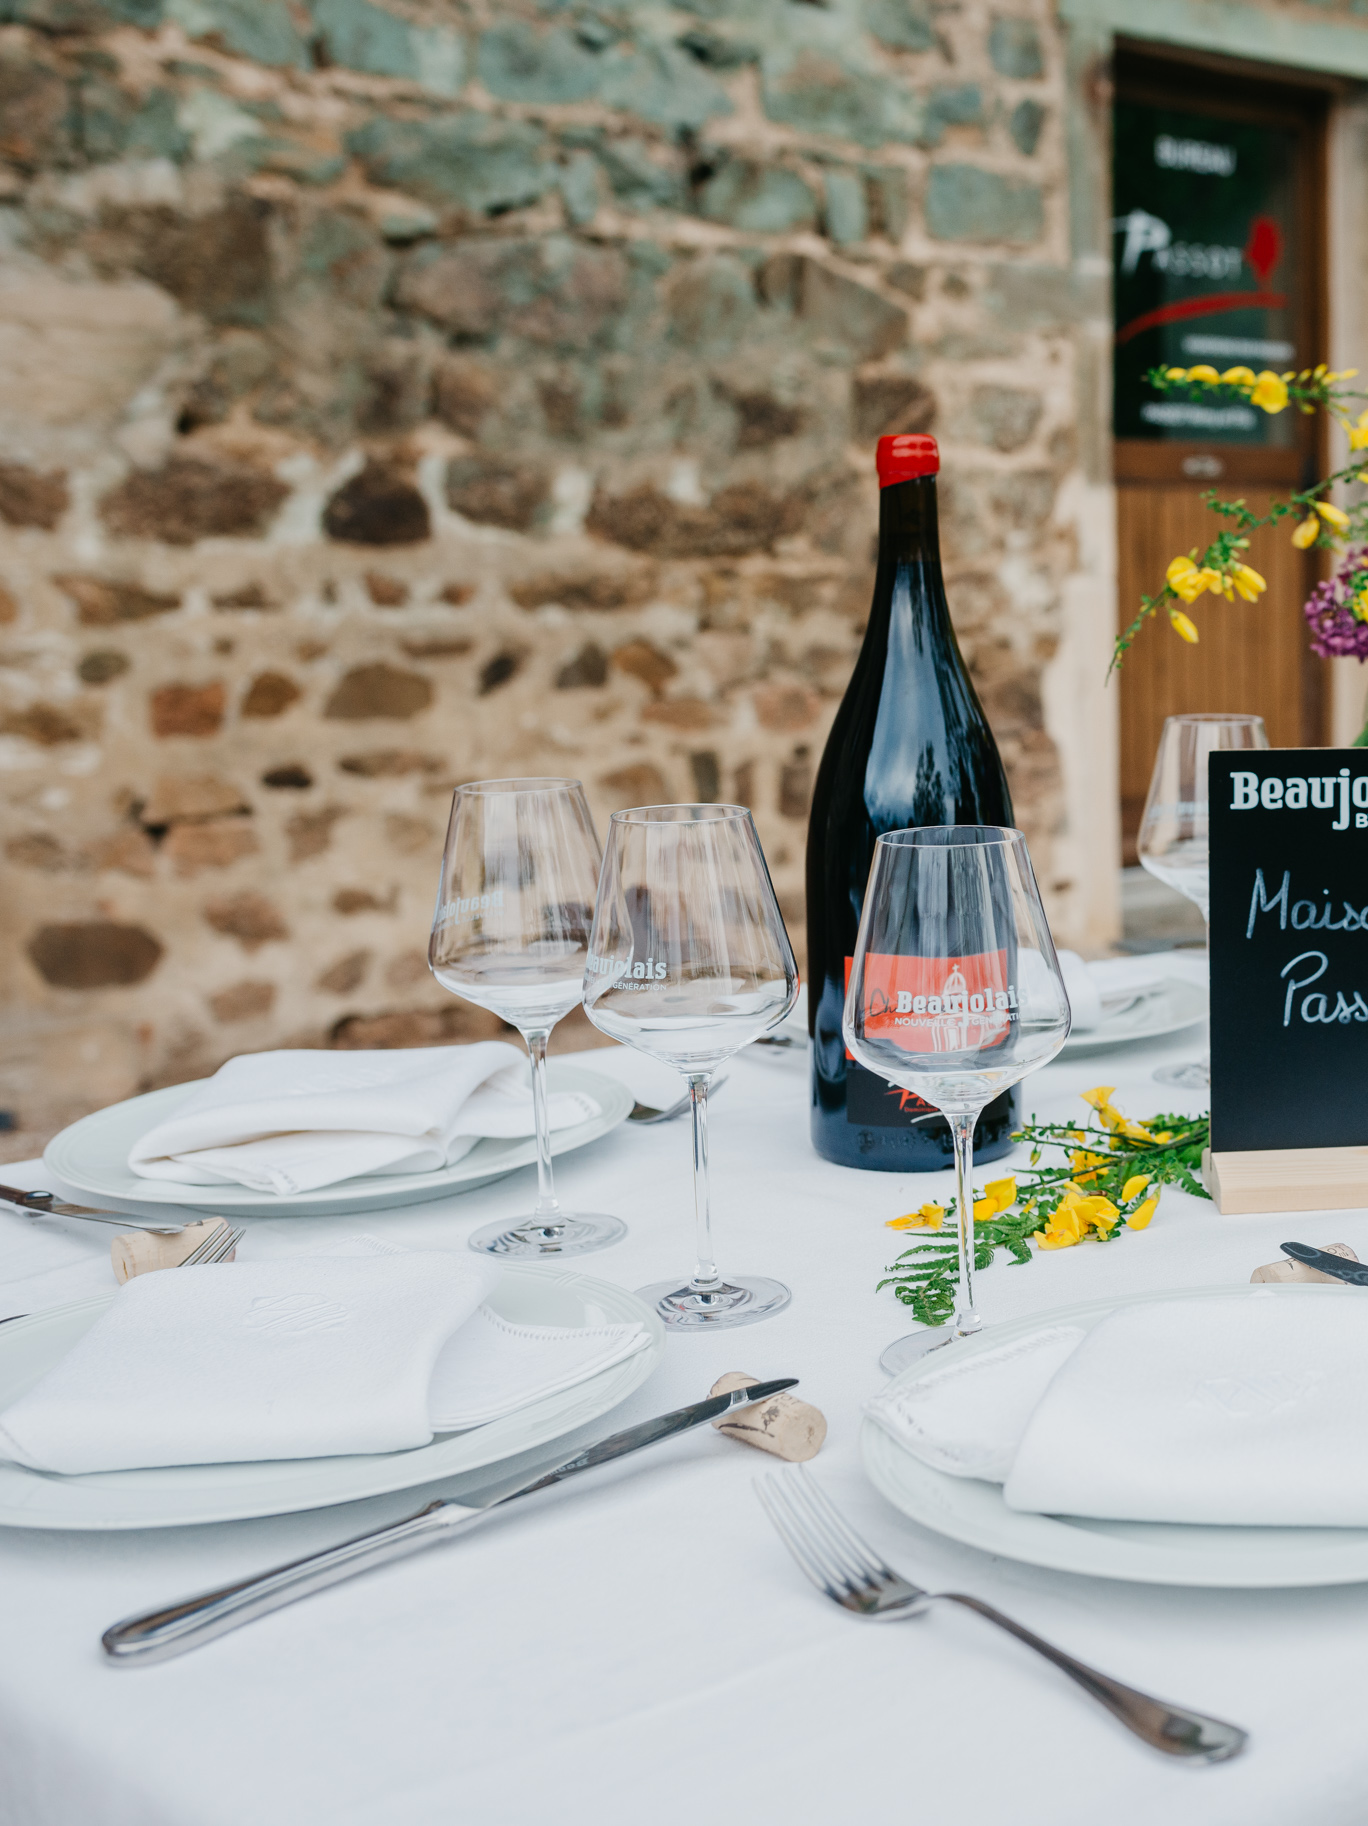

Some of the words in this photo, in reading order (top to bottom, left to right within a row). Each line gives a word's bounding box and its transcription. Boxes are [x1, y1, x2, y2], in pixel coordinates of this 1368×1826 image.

[612, 980, 667, 991] GÉNÉRATION
[895, 985, 1027, 1027] Beaujolais
[894, 1017, 957, 1027] NOUVELLE
